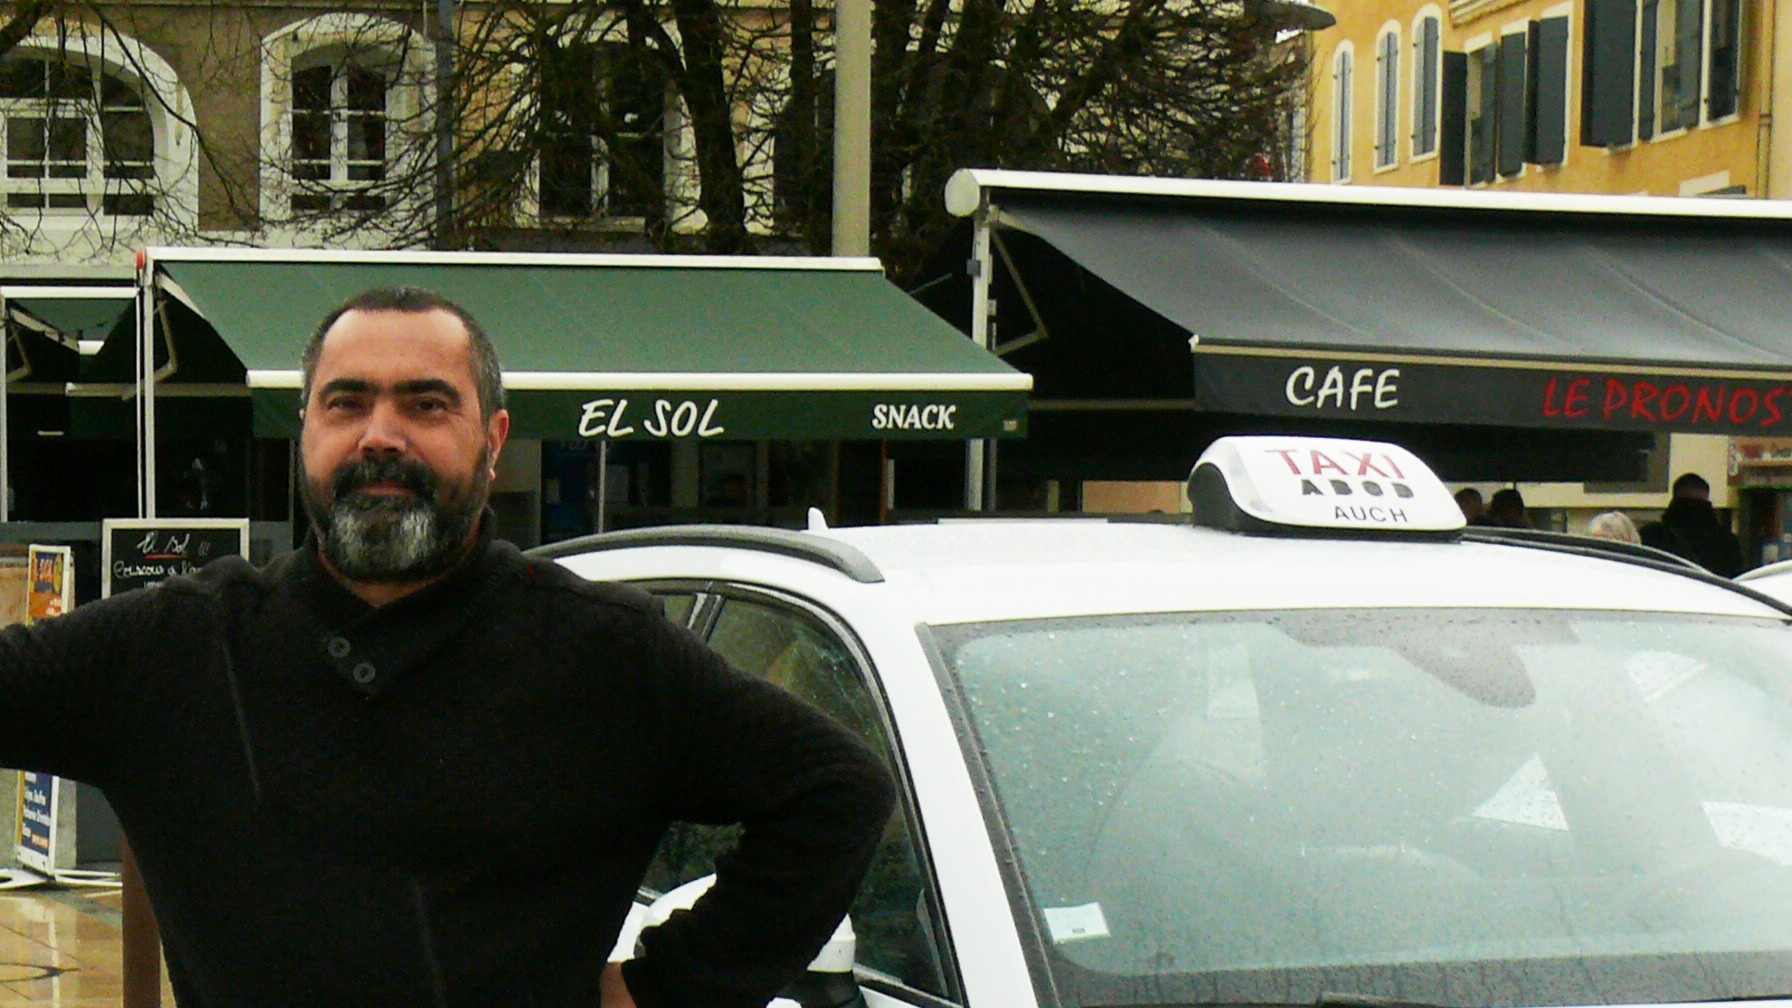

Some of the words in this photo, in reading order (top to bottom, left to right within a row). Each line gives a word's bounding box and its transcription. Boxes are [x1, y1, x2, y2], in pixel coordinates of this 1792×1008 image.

[1286, 365, 1400, 410] CAFE
[1542, 377, 1590, 417] LE
[1603, 378, 1792, 428] PRONOS
[579, 399, 634, 437] EL
[644, 399, 724, 437] SOL
[872, 404, 956, 429] SNACK
[1264, 449, 1406, 479] TAXI
[1335, 506, 1409, 524] AUCH
